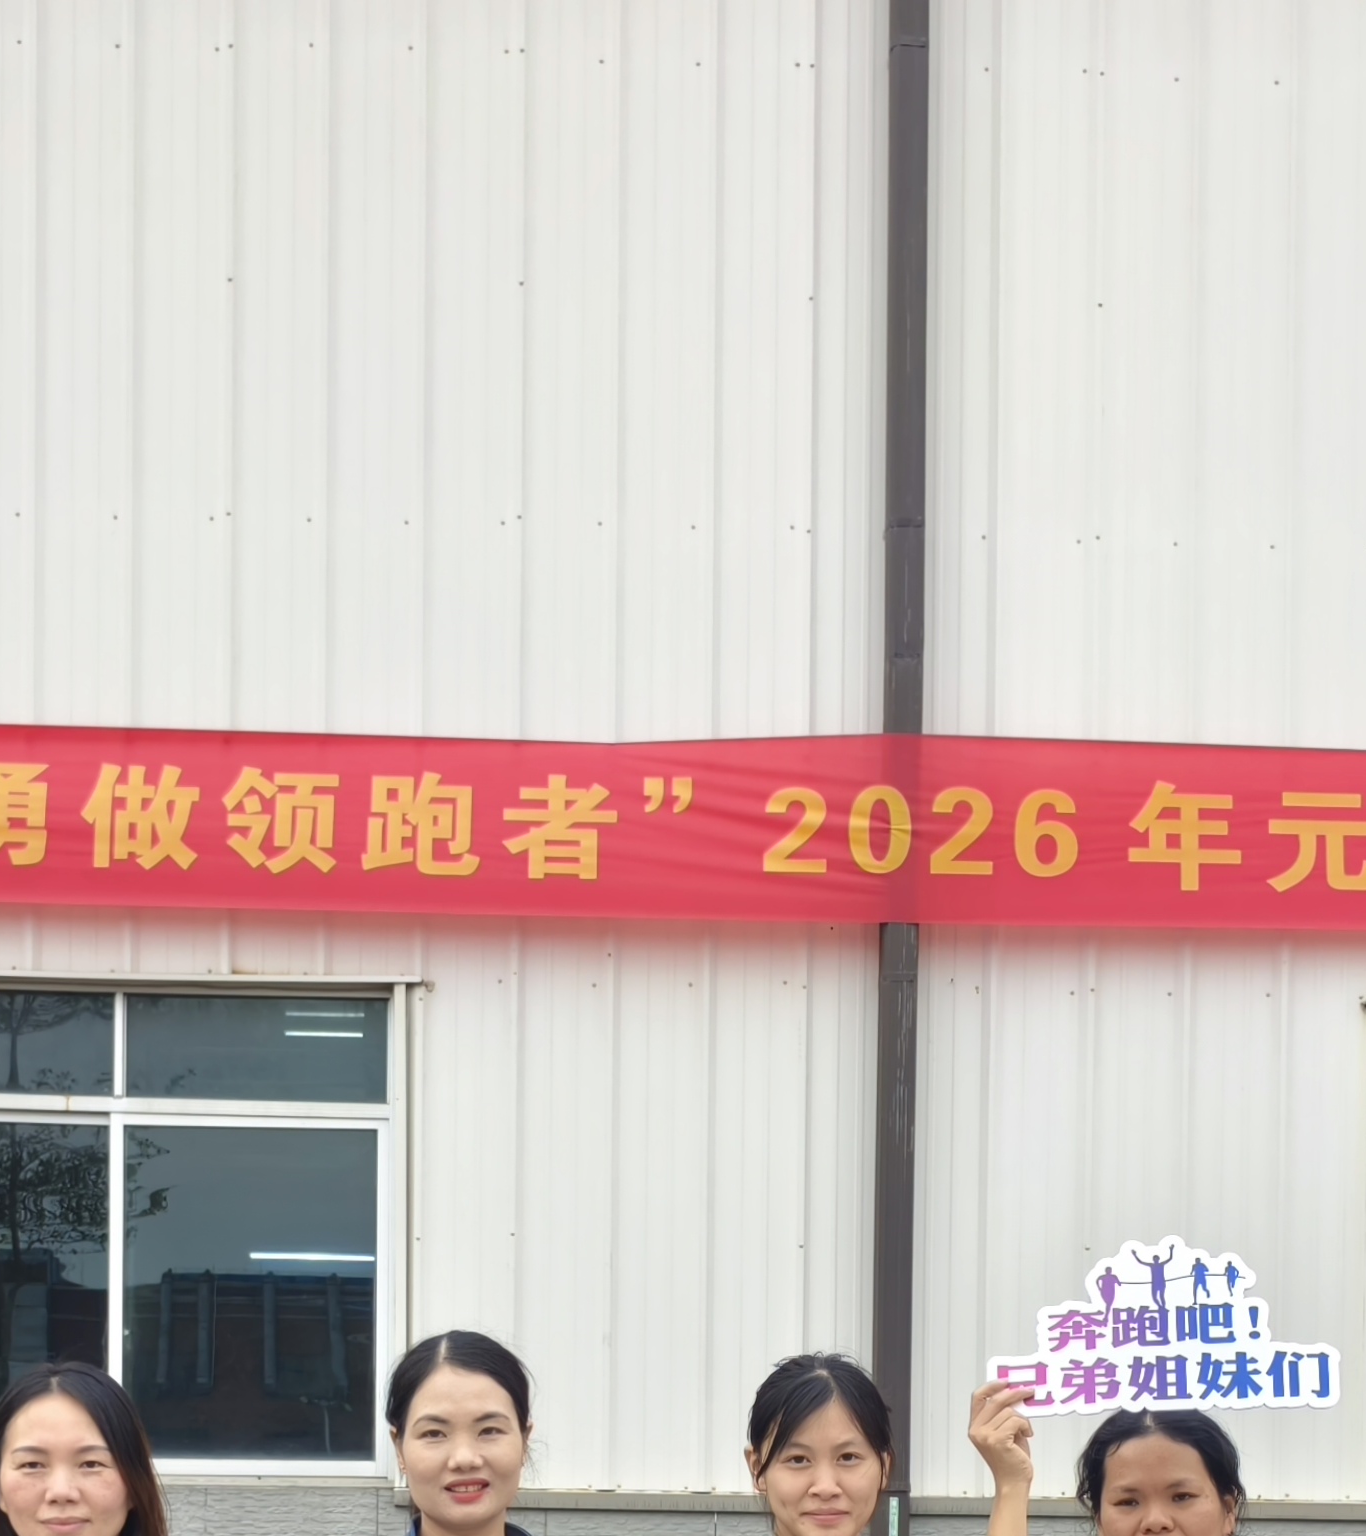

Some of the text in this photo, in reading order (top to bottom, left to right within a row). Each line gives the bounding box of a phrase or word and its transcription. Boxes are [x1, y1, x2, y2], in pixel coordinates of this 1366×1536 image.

[996, 1351, 1331, 1408] 兄弟姐妹们
